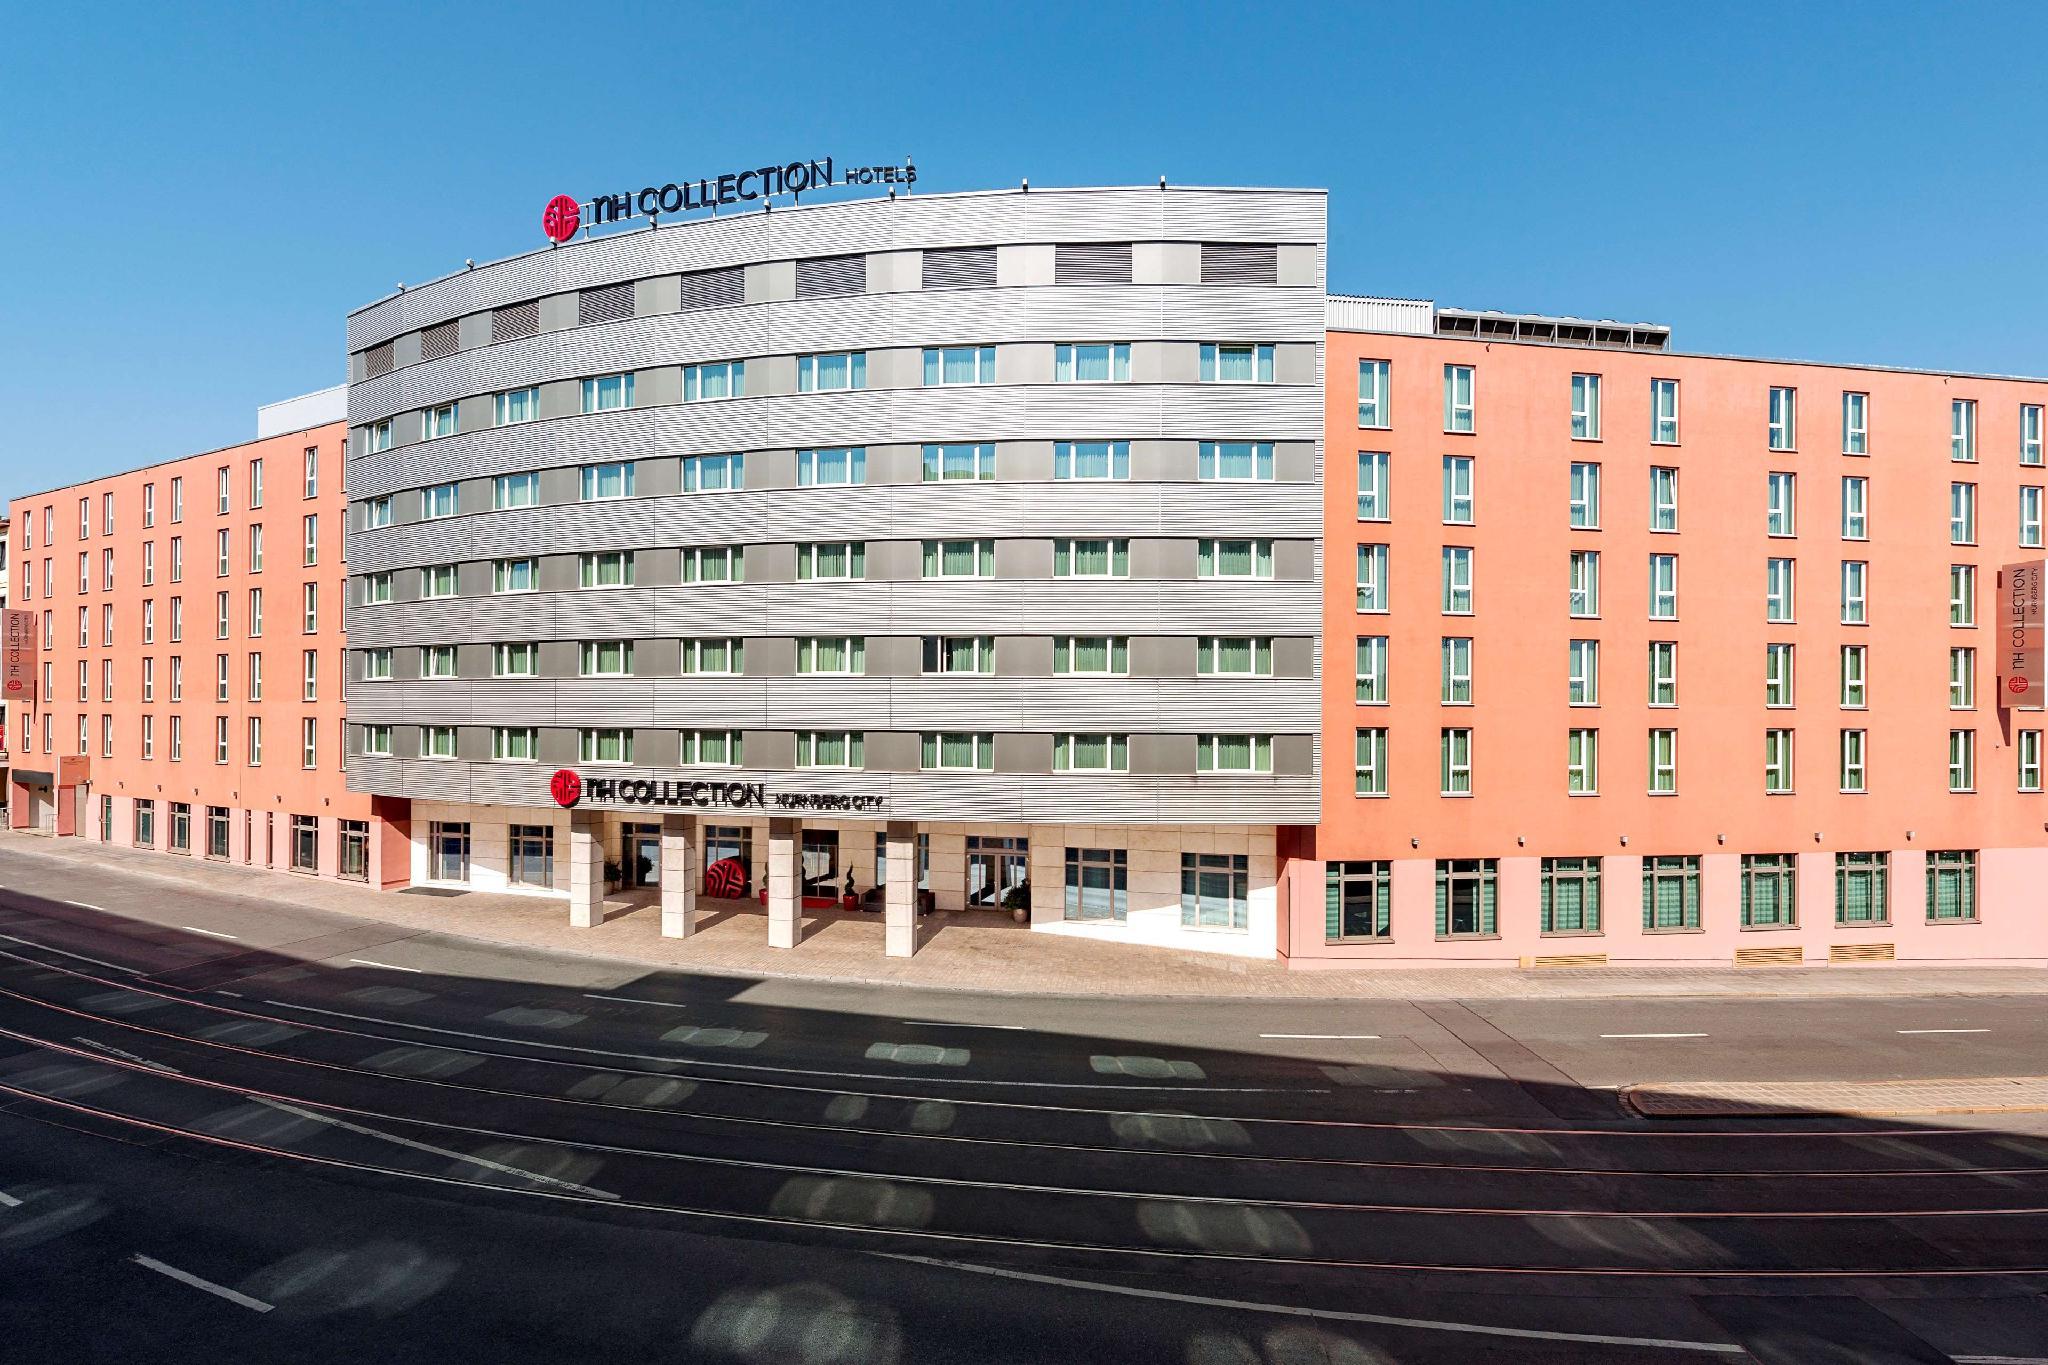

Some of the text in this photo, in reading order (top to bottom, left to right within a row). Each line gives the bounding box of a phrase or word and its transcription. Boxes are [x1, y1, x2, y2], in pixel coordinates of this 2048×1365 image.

[637, 156, 833, 216] COLLECTION
[845, 165, 918, 185] HOTELS
[2012, 568, 2025, 648] COLLECTION
[10, 613, 20, 663] COLLECTION
[618, 779, 765, 808] COLLECTION
